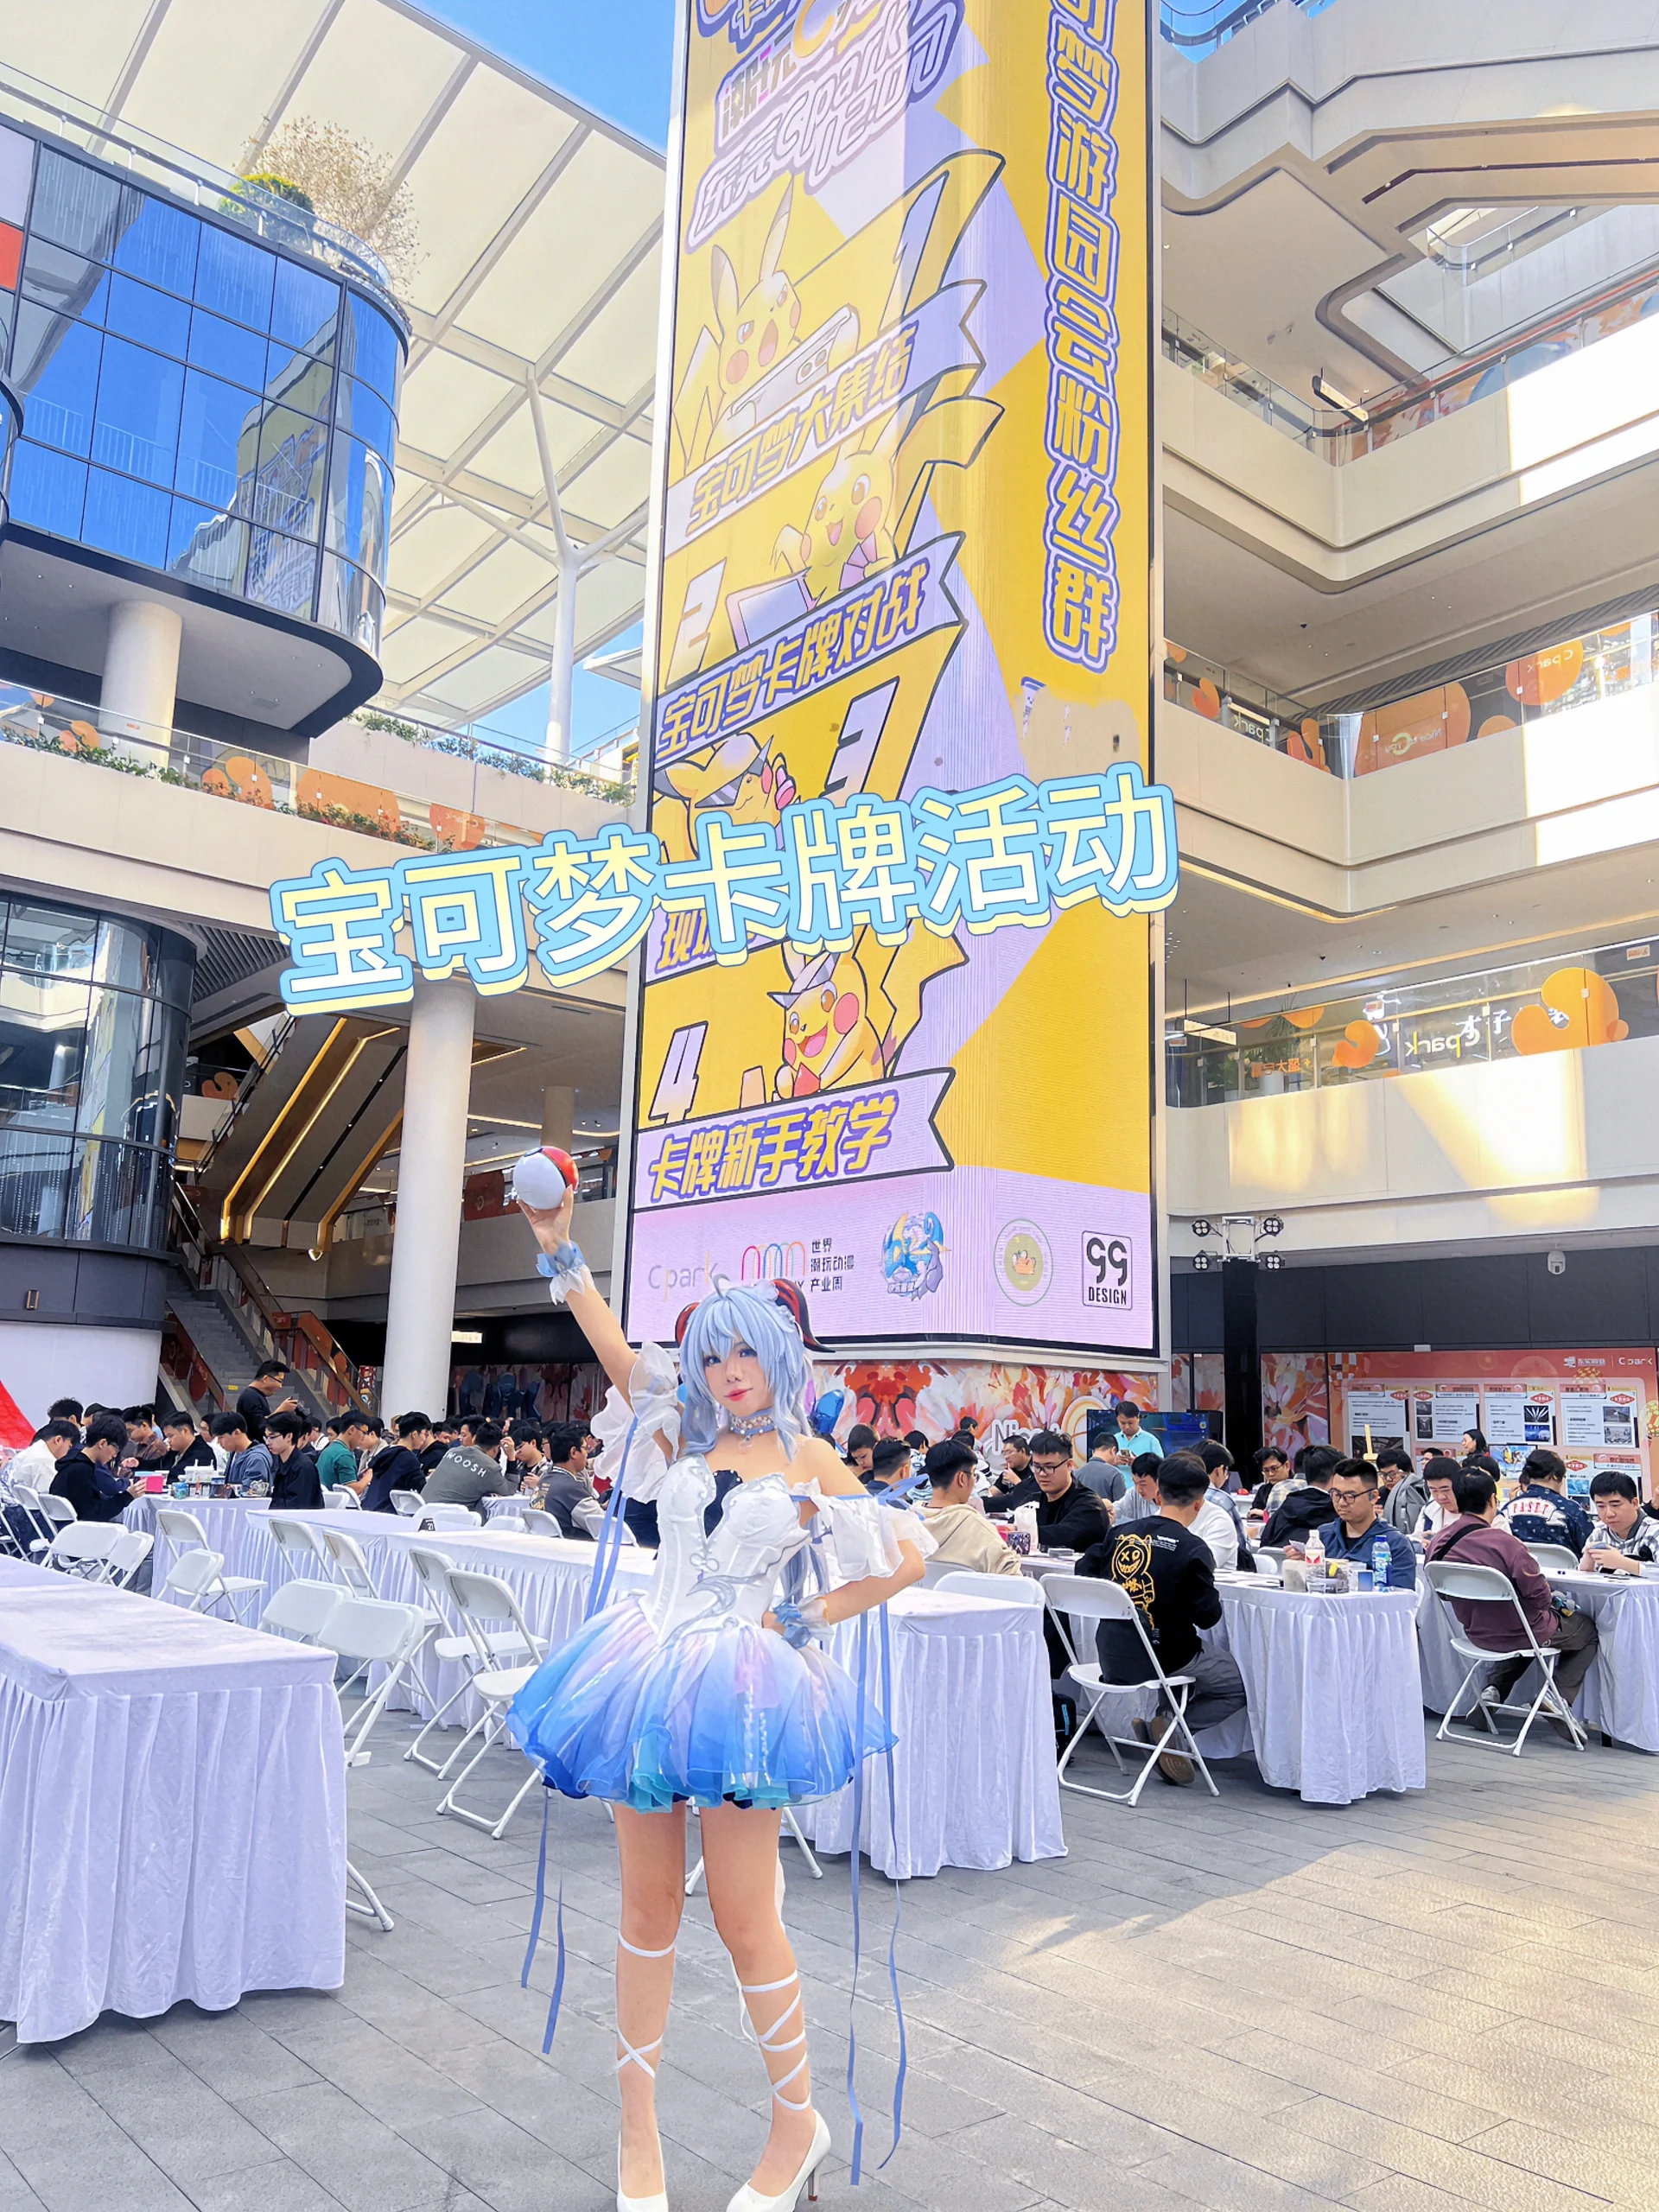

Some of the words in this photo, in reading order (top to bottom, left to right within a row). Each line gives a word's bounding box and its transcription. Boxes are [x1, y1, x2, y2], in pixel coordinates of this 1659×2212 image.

[687, 321, 919, 537] 宝可梦大集结
[656, 561, 929, 761] 宝可梦卡牌对战
[649, 1090, 899, 1203] 卡牌新手教学
[811, 1237, 832, 1254] 世界
[648, 1250, 719, 1303] Cpark
[810, 1255, 855, 1273] 潮玩动漫
[810, 1275, 842, 1293] 产业周
[1088, 1286, 1127, 1305] DESIGN
